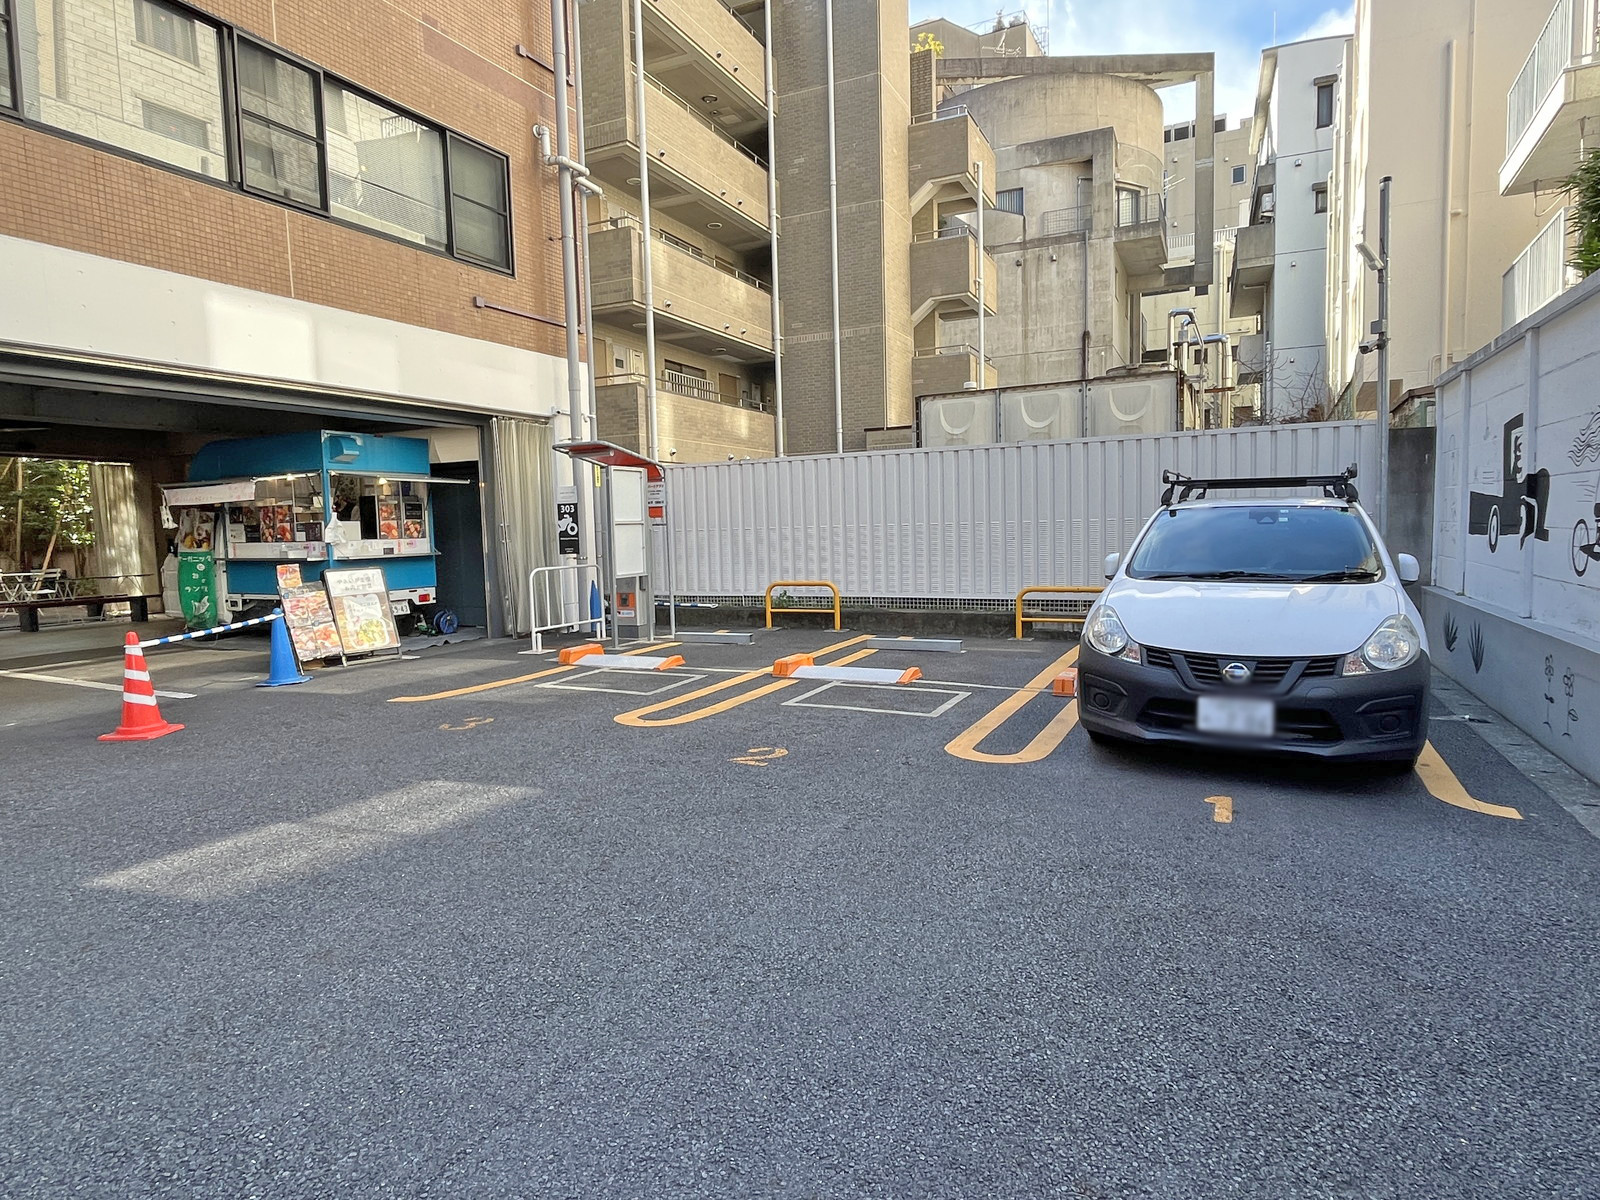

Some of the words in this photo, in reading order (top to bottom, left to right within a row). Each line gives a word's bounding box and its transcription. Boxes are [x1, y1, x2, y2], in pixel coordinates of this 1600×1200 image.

[560, 504, 575, 513] 303
[438, 716, 495, 731] 3
[727, 747, 789, 766] 2
[1203, 795, 1233, 823] 1
